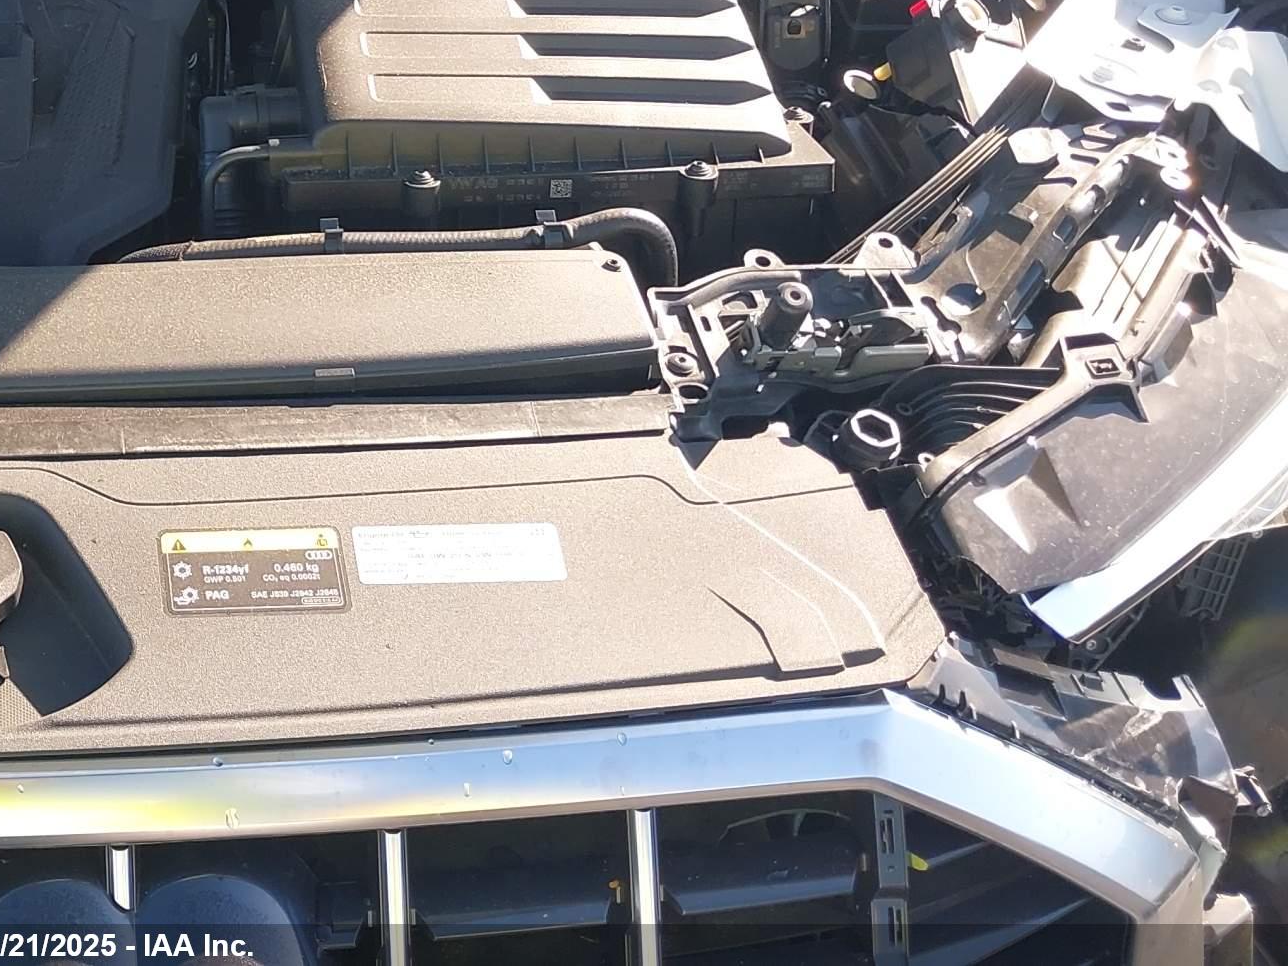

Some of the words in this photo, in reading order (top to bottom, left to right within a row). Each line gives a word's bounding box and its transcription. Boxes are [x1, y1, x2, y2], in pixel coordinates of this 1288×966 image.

[202, 563, 249, 576] R-1234yf
[305, 563, 320, 575] kg
[204, 576, 224, 584] GWP
[204, 590, 230, 601] PAG
[250, 590, 268, 599] SAE
